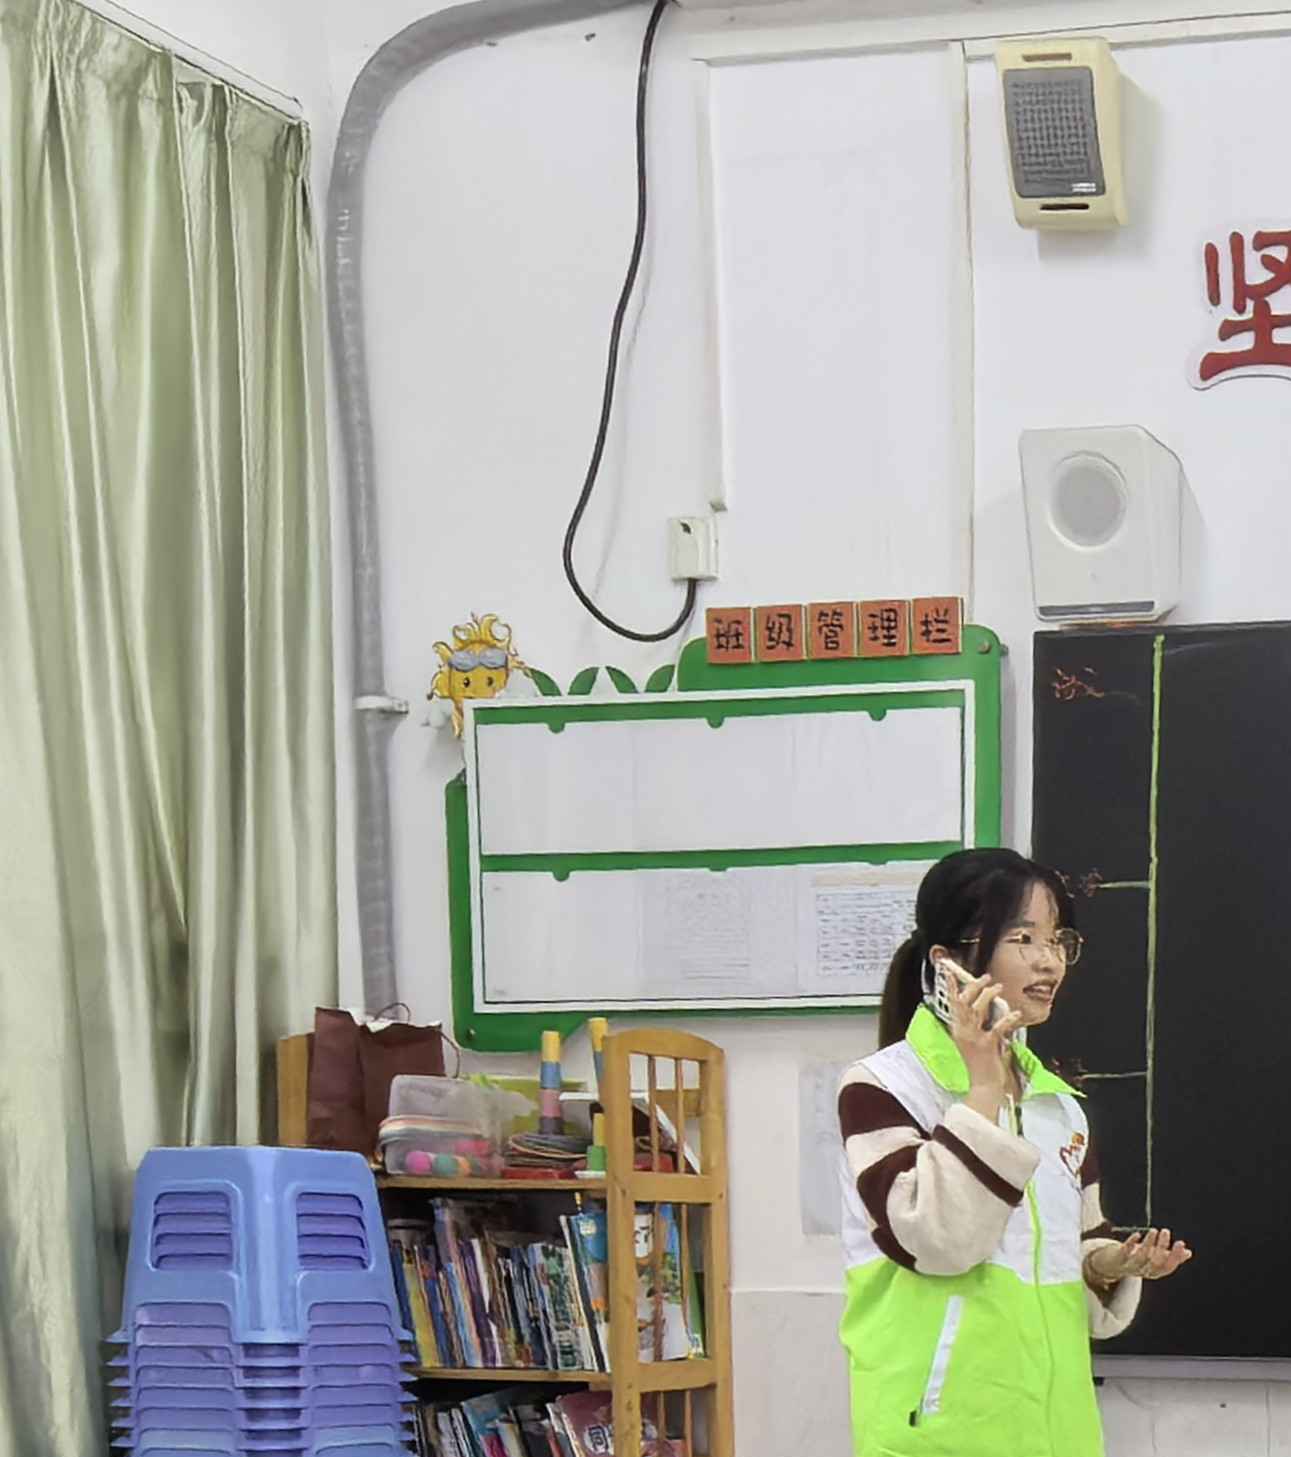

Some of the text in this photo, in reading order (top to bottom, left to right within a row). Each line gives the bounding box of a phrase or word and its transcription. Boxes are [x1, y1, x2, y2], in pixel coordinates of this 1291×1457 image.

[713, 607, 953, 651] 班级管理栏
